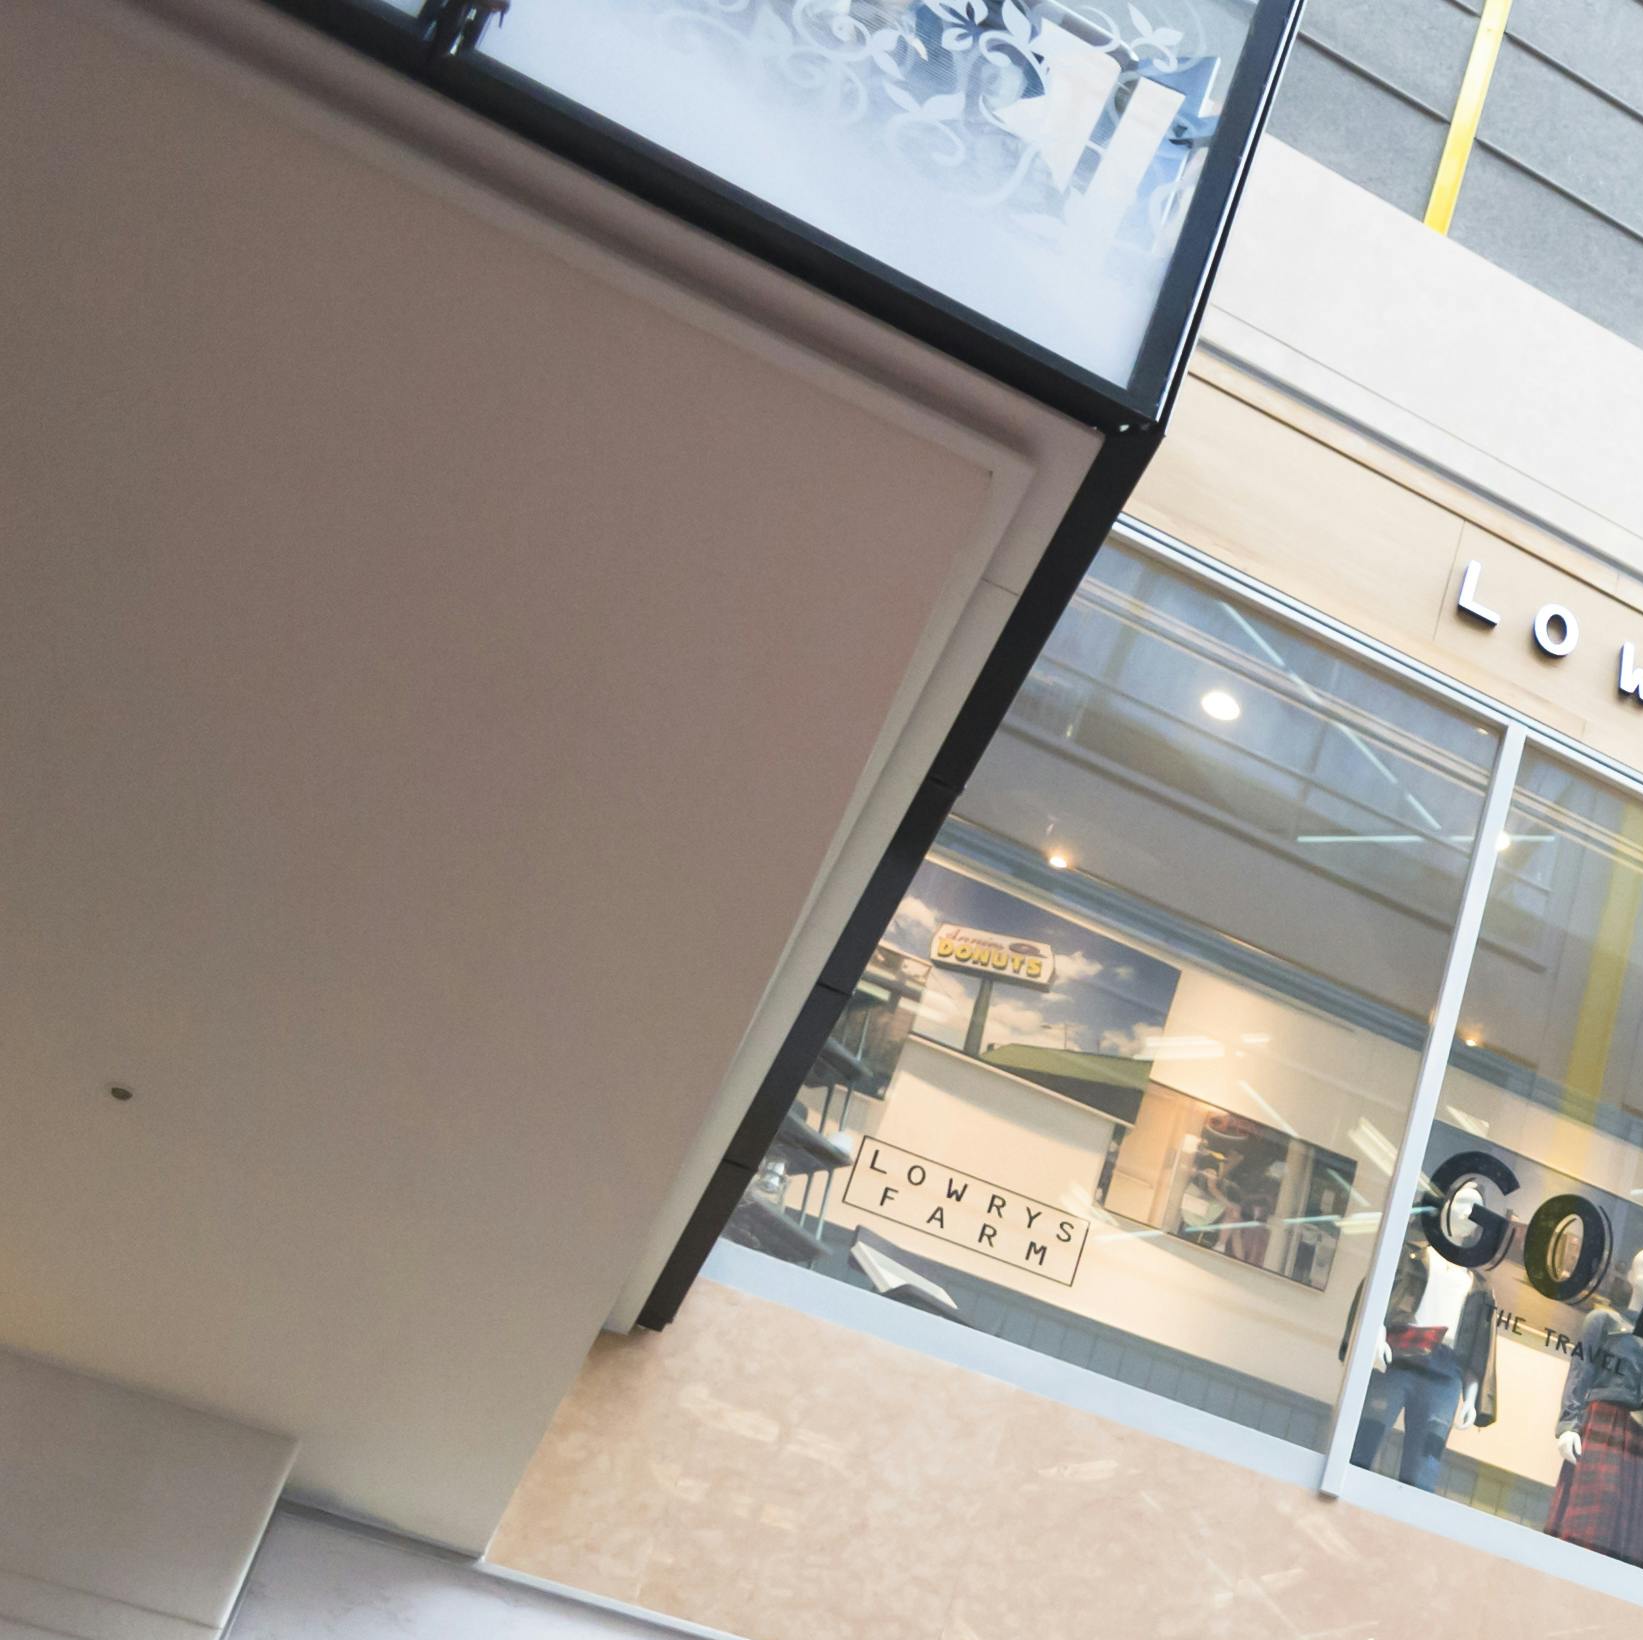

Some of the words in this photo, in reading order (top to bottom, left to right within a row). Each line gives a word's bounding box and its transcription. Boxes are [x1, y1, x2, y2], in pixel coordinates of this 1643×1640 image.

[937, 937, 1042, 977] DONUTS
[868, 1149, 1075, 1244] LOWRYS
[879, 1186, 1048, 1267] FARM
[1420, 1149, 1614, 1302] GO
[1544, 1326, 1626, 1377] TRAVEL
